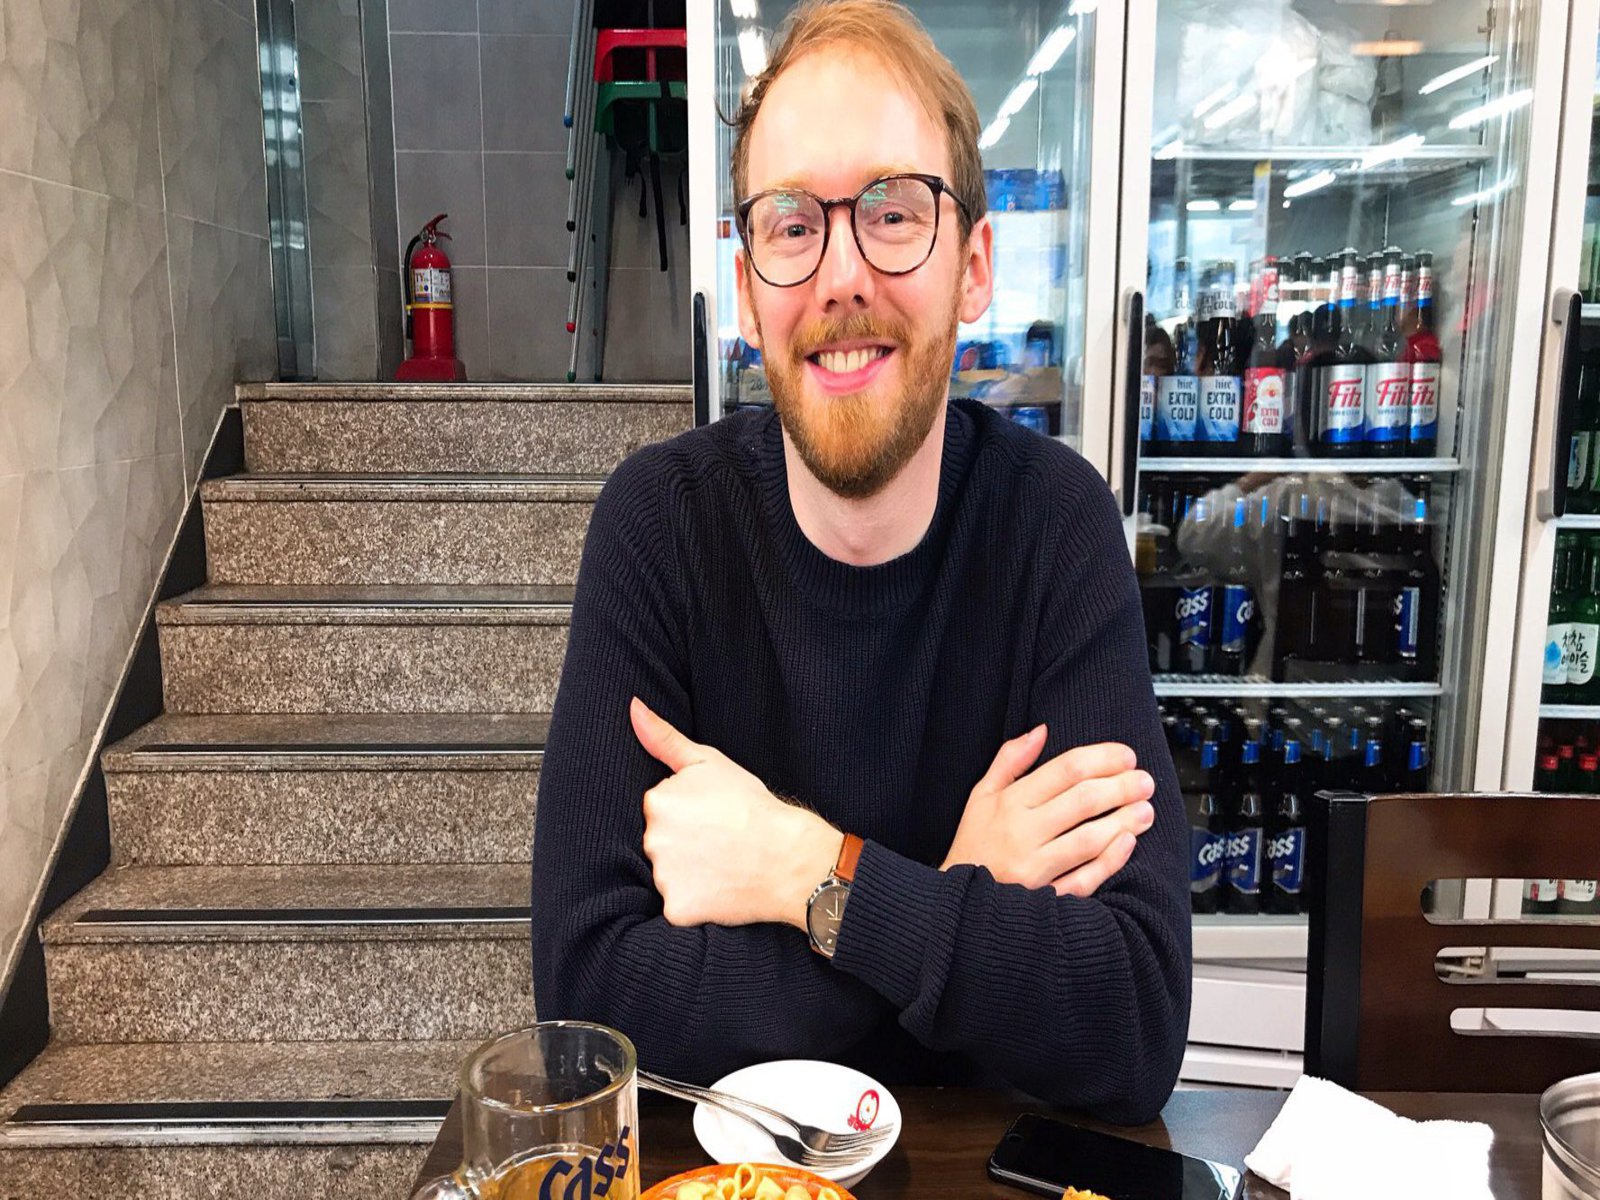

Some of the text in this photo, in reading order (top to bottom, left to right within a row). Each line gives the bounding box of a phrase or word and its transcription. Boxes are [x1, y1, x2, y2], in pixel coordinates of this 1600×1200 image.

[1168, 392, 1197, 405] EXTRA
[1207, 391, 1236, 405] EXTRA
[1328, 377, 1362, 408] Fitz
[1171, 407, 1195, 420] COLD
[1209, 407, 1234, 420] COLD
